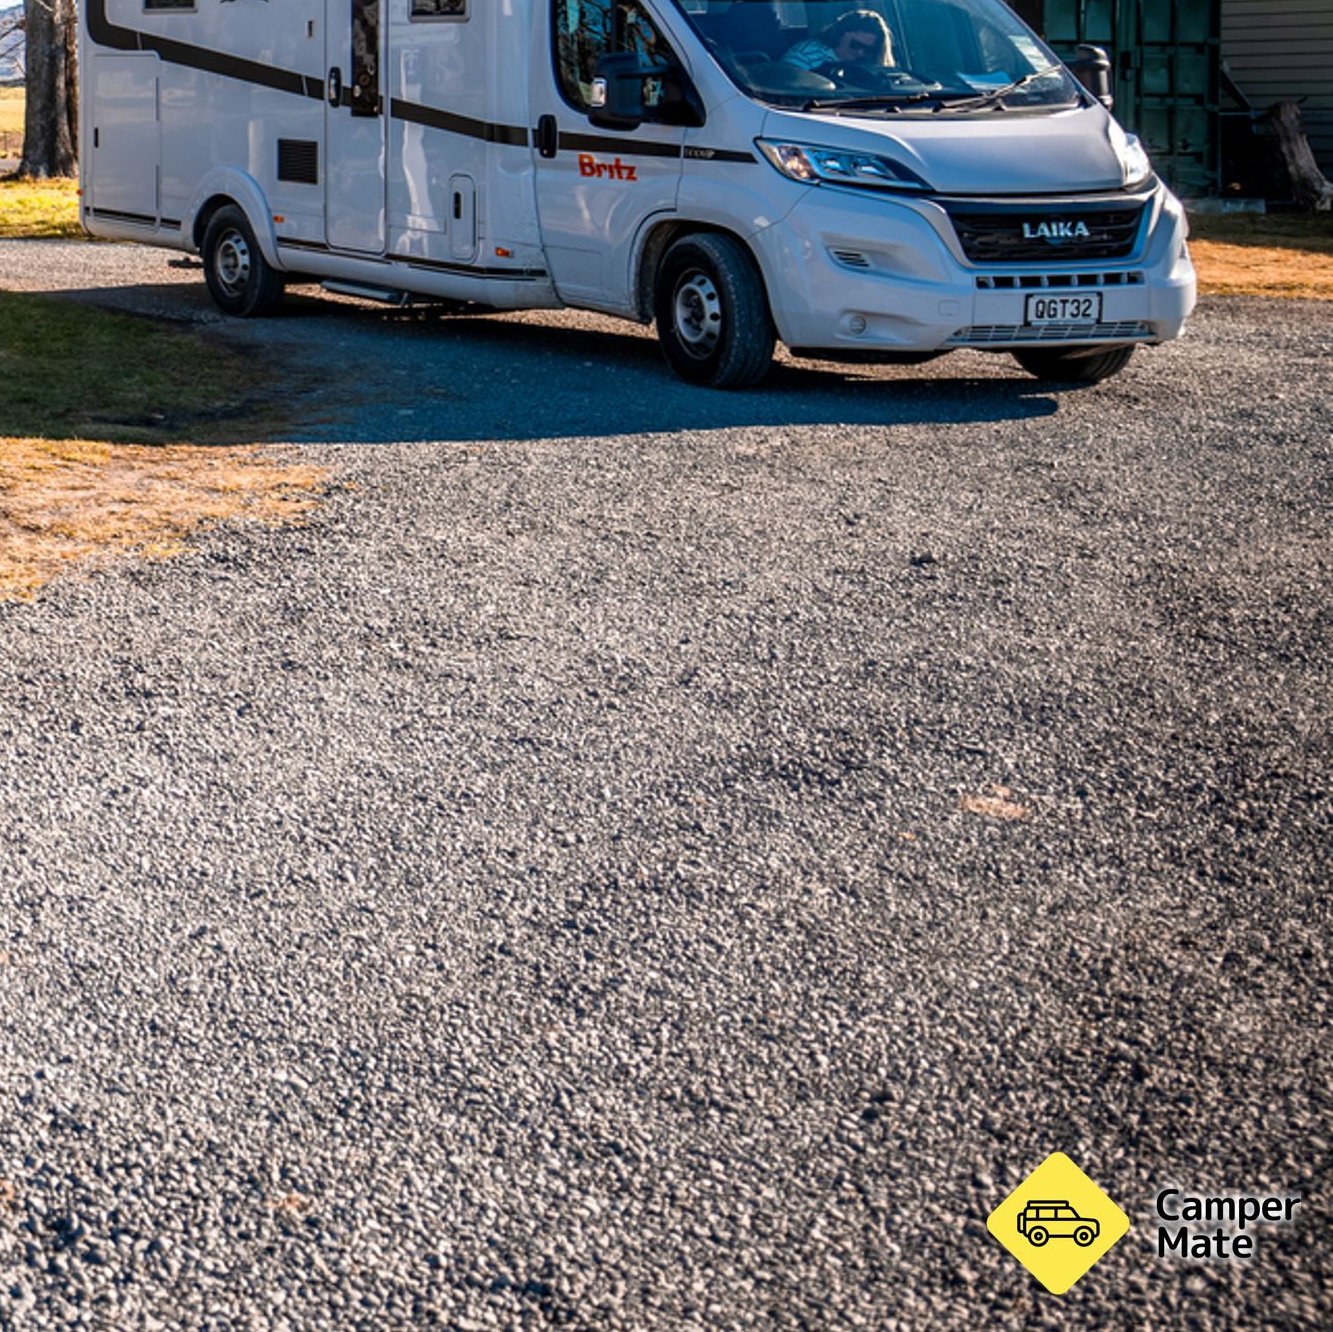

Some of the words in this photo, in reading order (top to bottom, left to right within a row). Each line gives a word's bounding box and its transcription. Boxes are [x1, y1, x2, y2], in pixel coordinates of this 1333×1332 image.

[578, 154, 638, 181] Britz
[1022, 221, 1090, 238] LAIKA
[1035, 299, 1093, 319] QGT32
